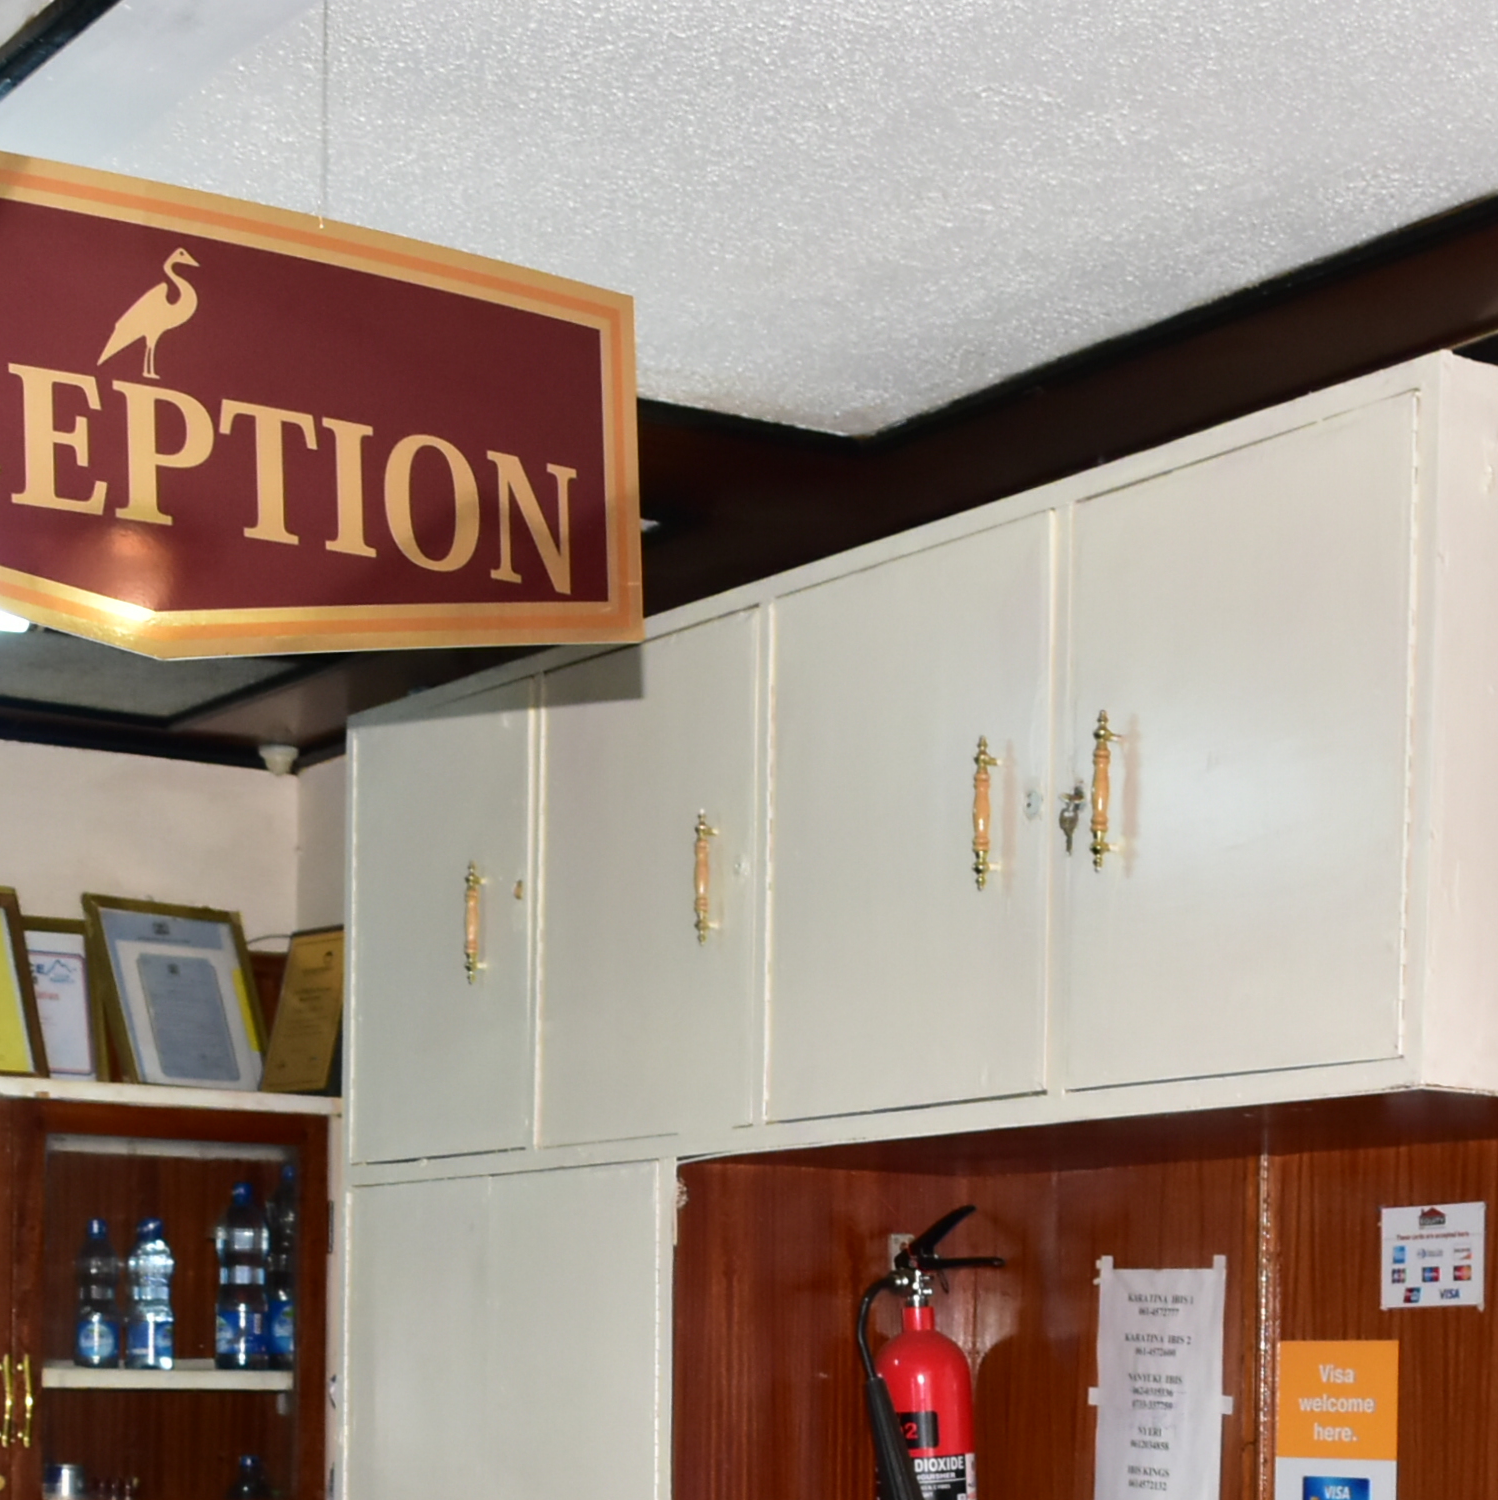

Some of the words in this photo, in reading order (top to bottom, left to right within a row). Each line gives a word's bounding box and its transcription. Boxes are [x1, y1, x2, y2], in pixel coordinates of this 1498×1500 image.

[1440, 1289, 1460, 1299] VISA
[1319, 1364, 1355, 1384] Visa
[1299, 1395, 1376, 1413] welcome
[1313, 1422, 1358, 1442] here.
[914, 1456, 965, 1472] DIOXIDE
[1324, 1485, 1350, 1500] VISA
